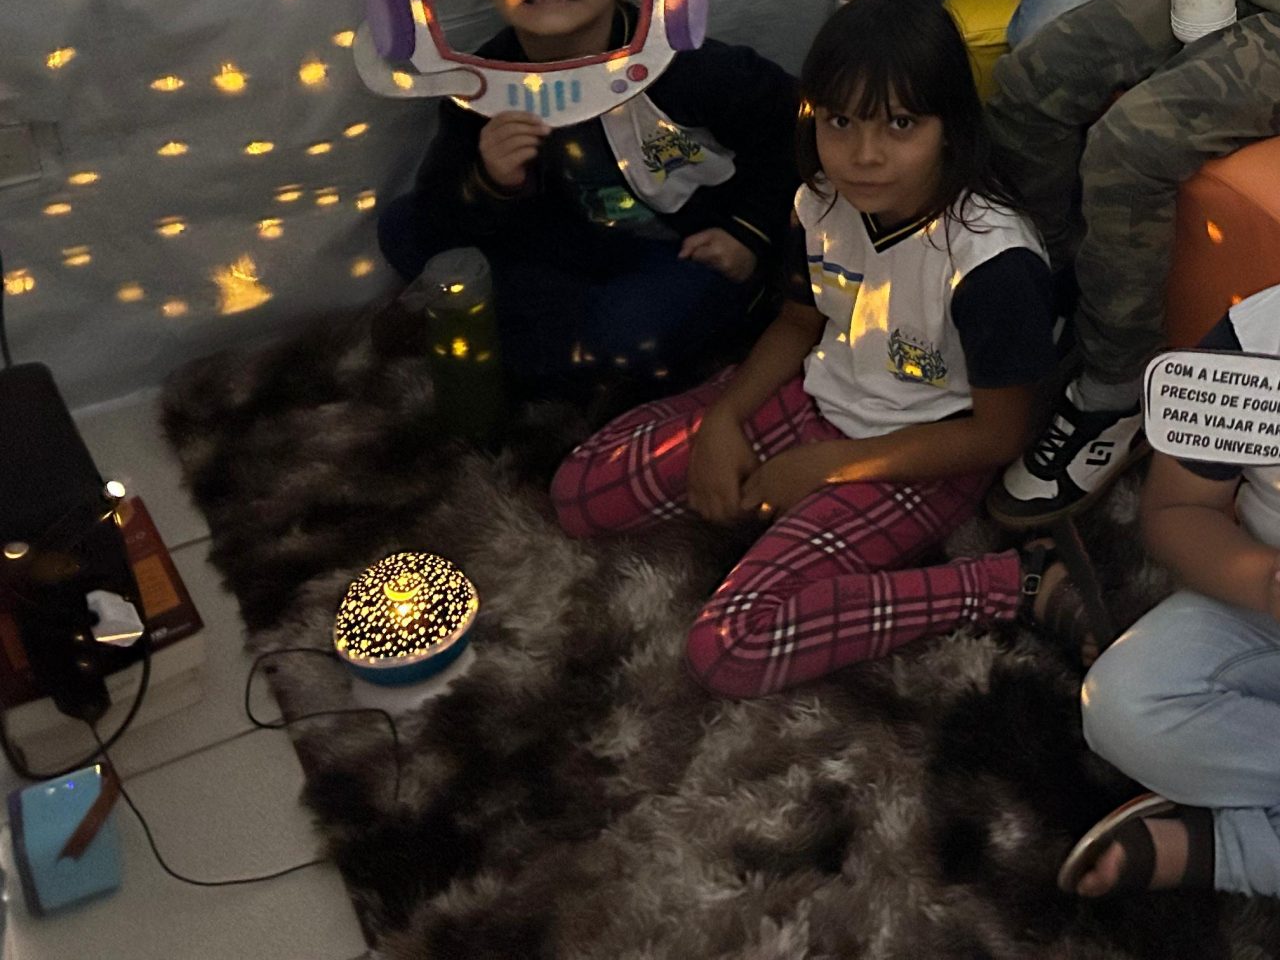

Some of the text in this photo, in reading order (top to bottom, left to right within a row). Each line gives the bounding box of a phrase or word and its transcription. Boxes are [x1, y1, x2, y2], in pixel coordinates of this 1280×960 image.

[1165, 362, 1193, 378] COM
[1198, 368, 1207, 380] A
[1212, 370, 1272, 391] LEITURA,
[1161, 385, 1216, 404] PRECISO
[1220, 394, 1239, 408] DE
[1163, 408, 1198, 424] PARA
[1204, 414, 1254, 432] VIAJAR
[1167, 430, 1210, 448] OUTRO
